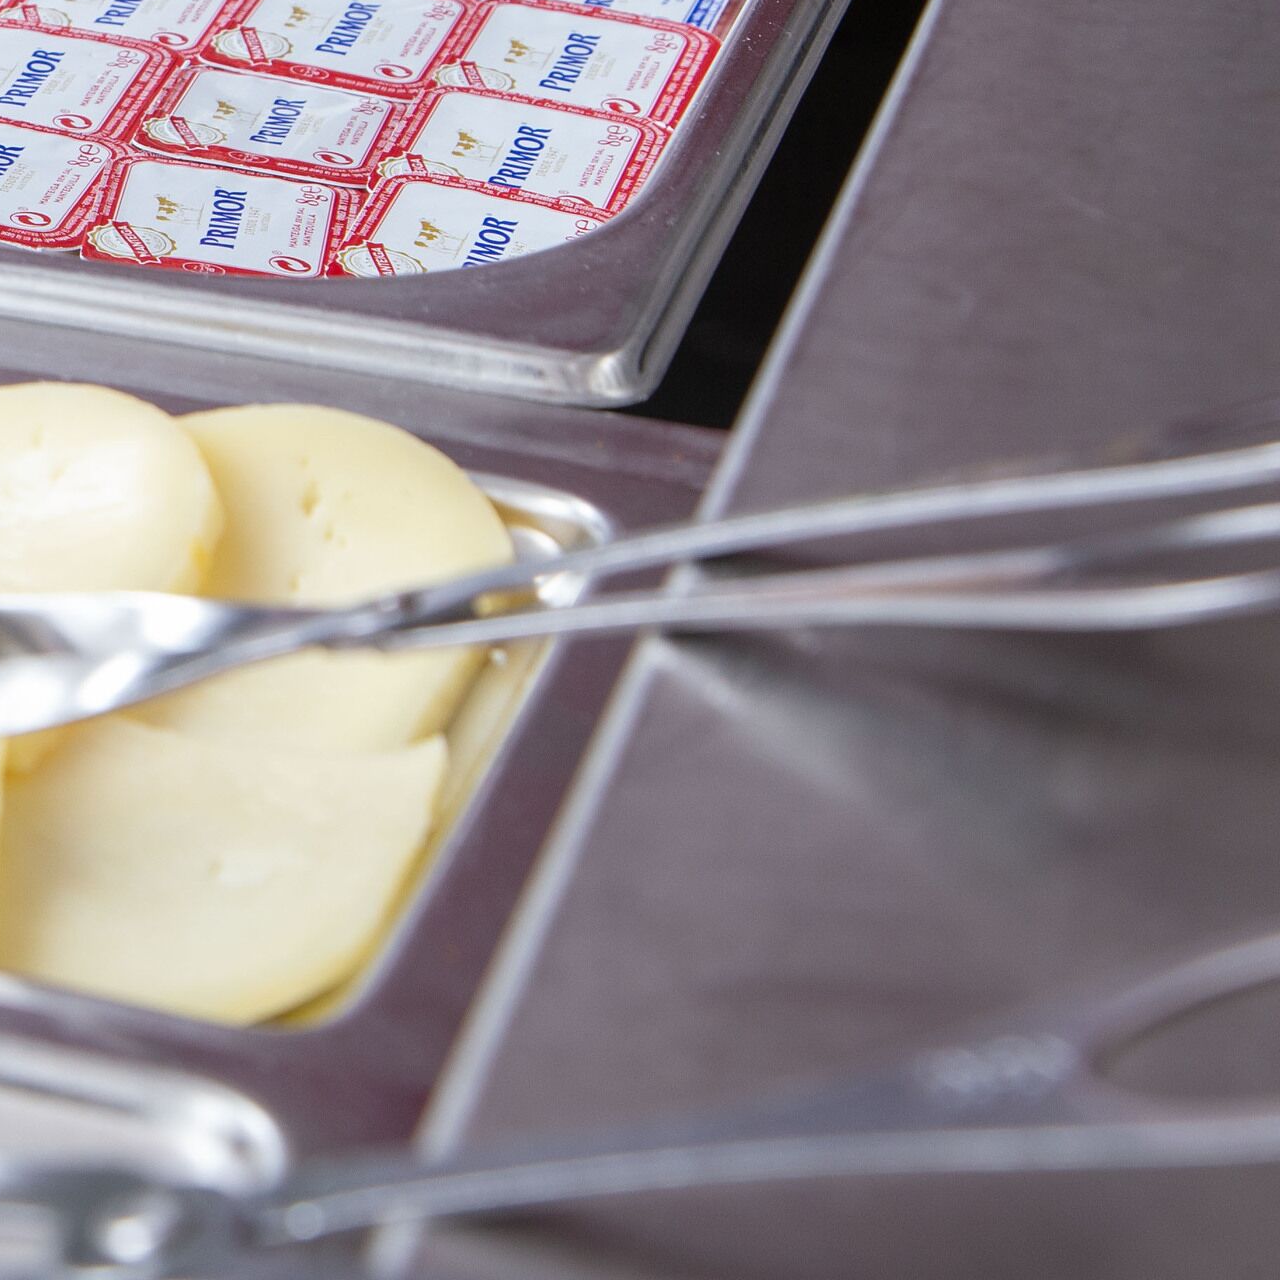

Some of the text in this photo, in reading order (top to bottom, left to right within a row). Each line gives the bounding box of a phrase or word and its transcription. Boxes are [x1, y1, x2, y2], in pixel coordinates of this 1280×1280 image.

[315, 0, 382, 56] PRIMOR
[540, 31, 600, 92] PRIMOR
[250, 96, 307, 145] PRIMOR
[488, 122, 552, 189] PRIMOR
[118, 224, 151, 260] MANTEIGA
[200, 187, 248, 249] PRIMOR
[462, 214, 519, 268] IMOR
